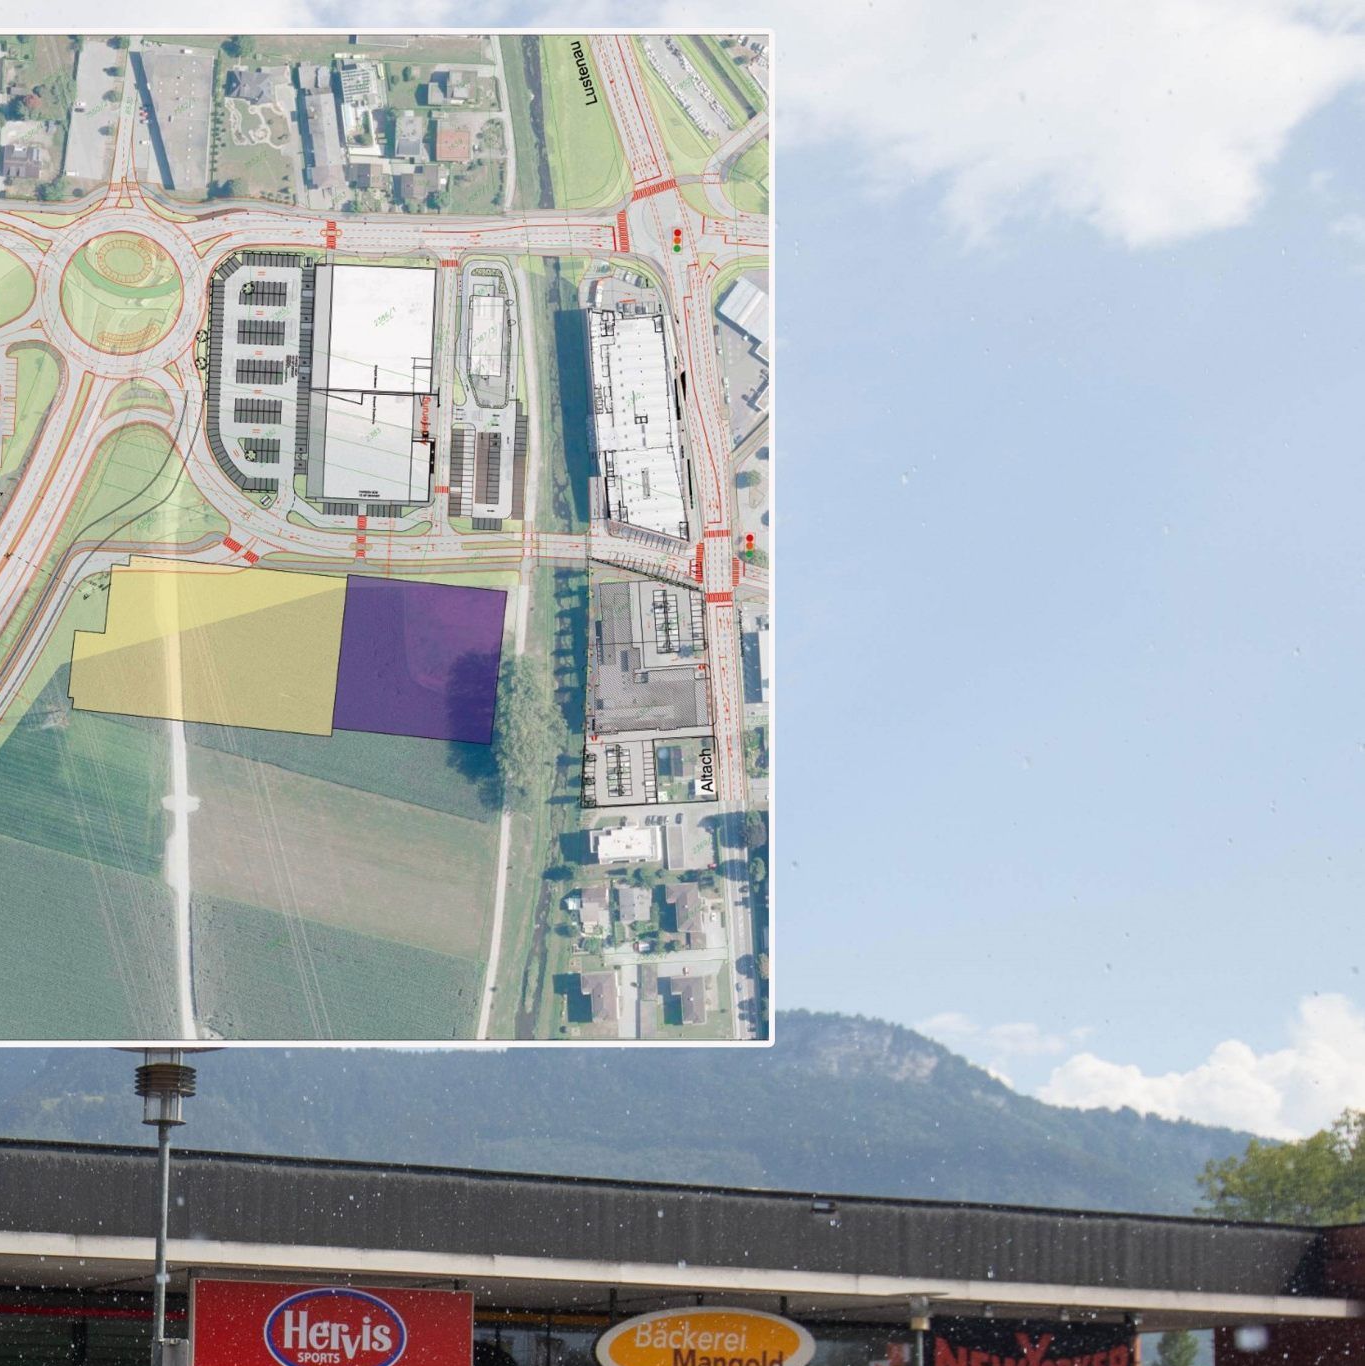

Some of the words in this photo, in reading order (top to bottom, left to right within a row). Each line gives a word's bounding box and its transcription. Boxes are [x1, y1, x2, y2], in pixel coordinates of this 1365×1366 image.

[282, 1308, 392, 1360] Hervis
[634, 1320, 747, 1351] Bäckerei
[297, 1351, 340, 1365] SPORTS
